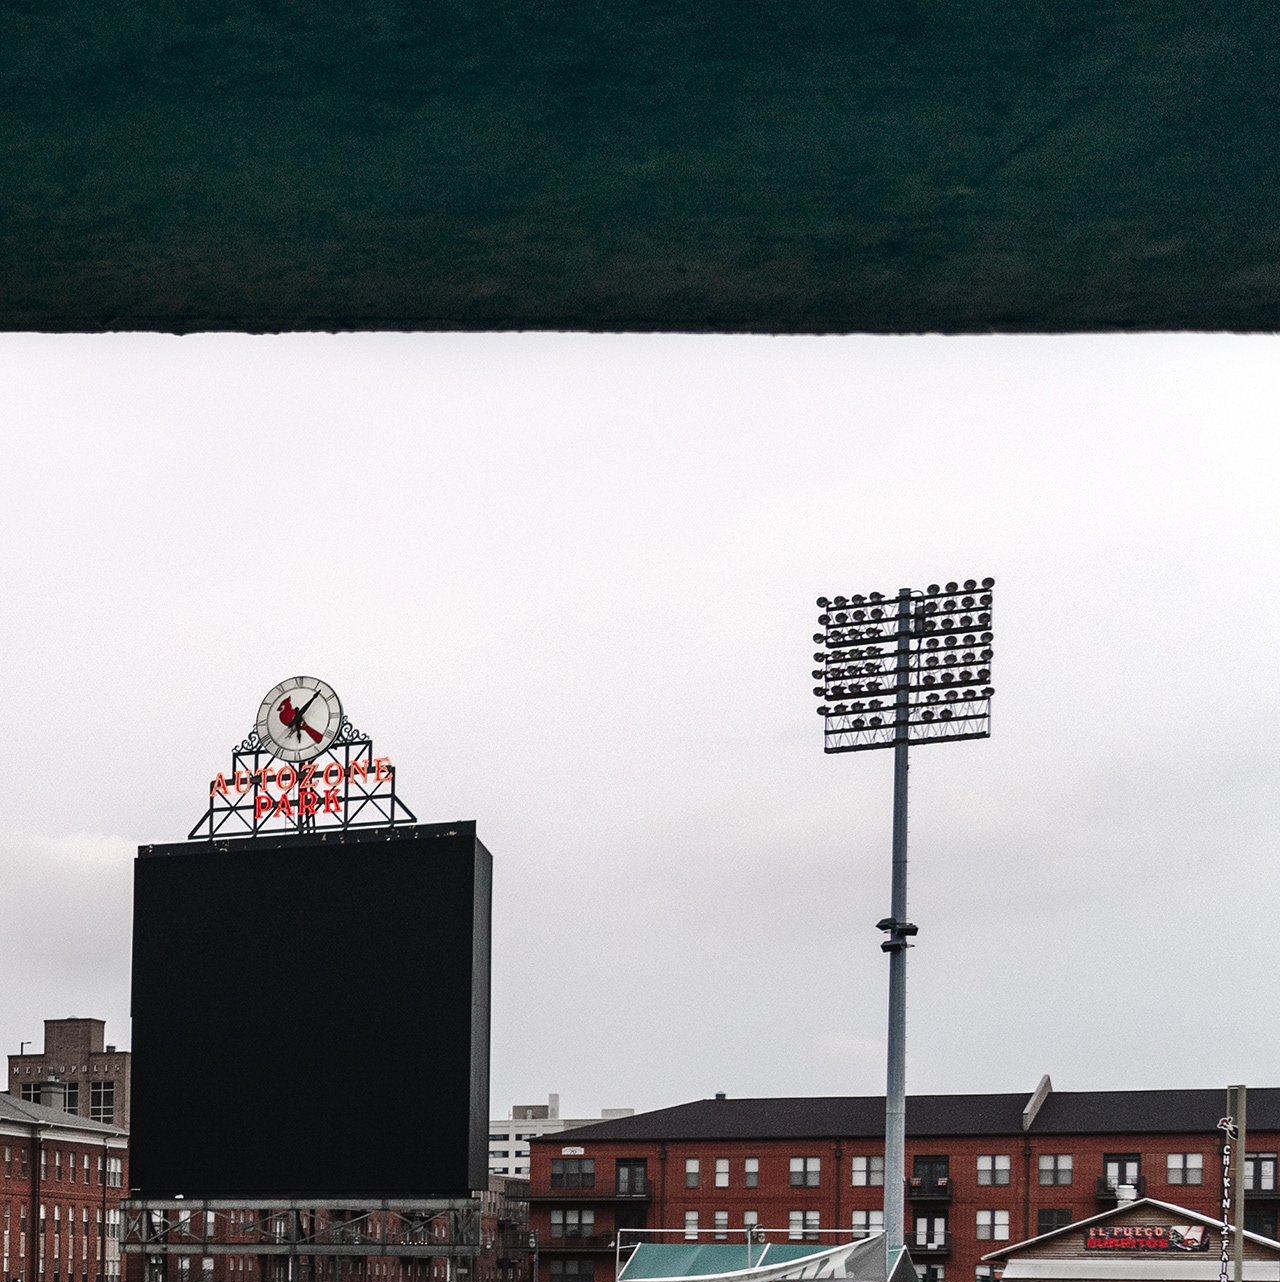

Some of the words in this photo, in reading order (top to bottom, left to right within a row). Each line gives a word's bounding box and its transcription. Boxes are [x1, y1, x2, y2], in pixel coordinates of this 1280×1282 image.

[209, 757, 394, 797] AUTOZONE
[255, 788, 342, 819] PARK
[1222, 1145, 1231, 1209] CHIKIN
[1087, 1238, 1169, 1249] BURRITOS
